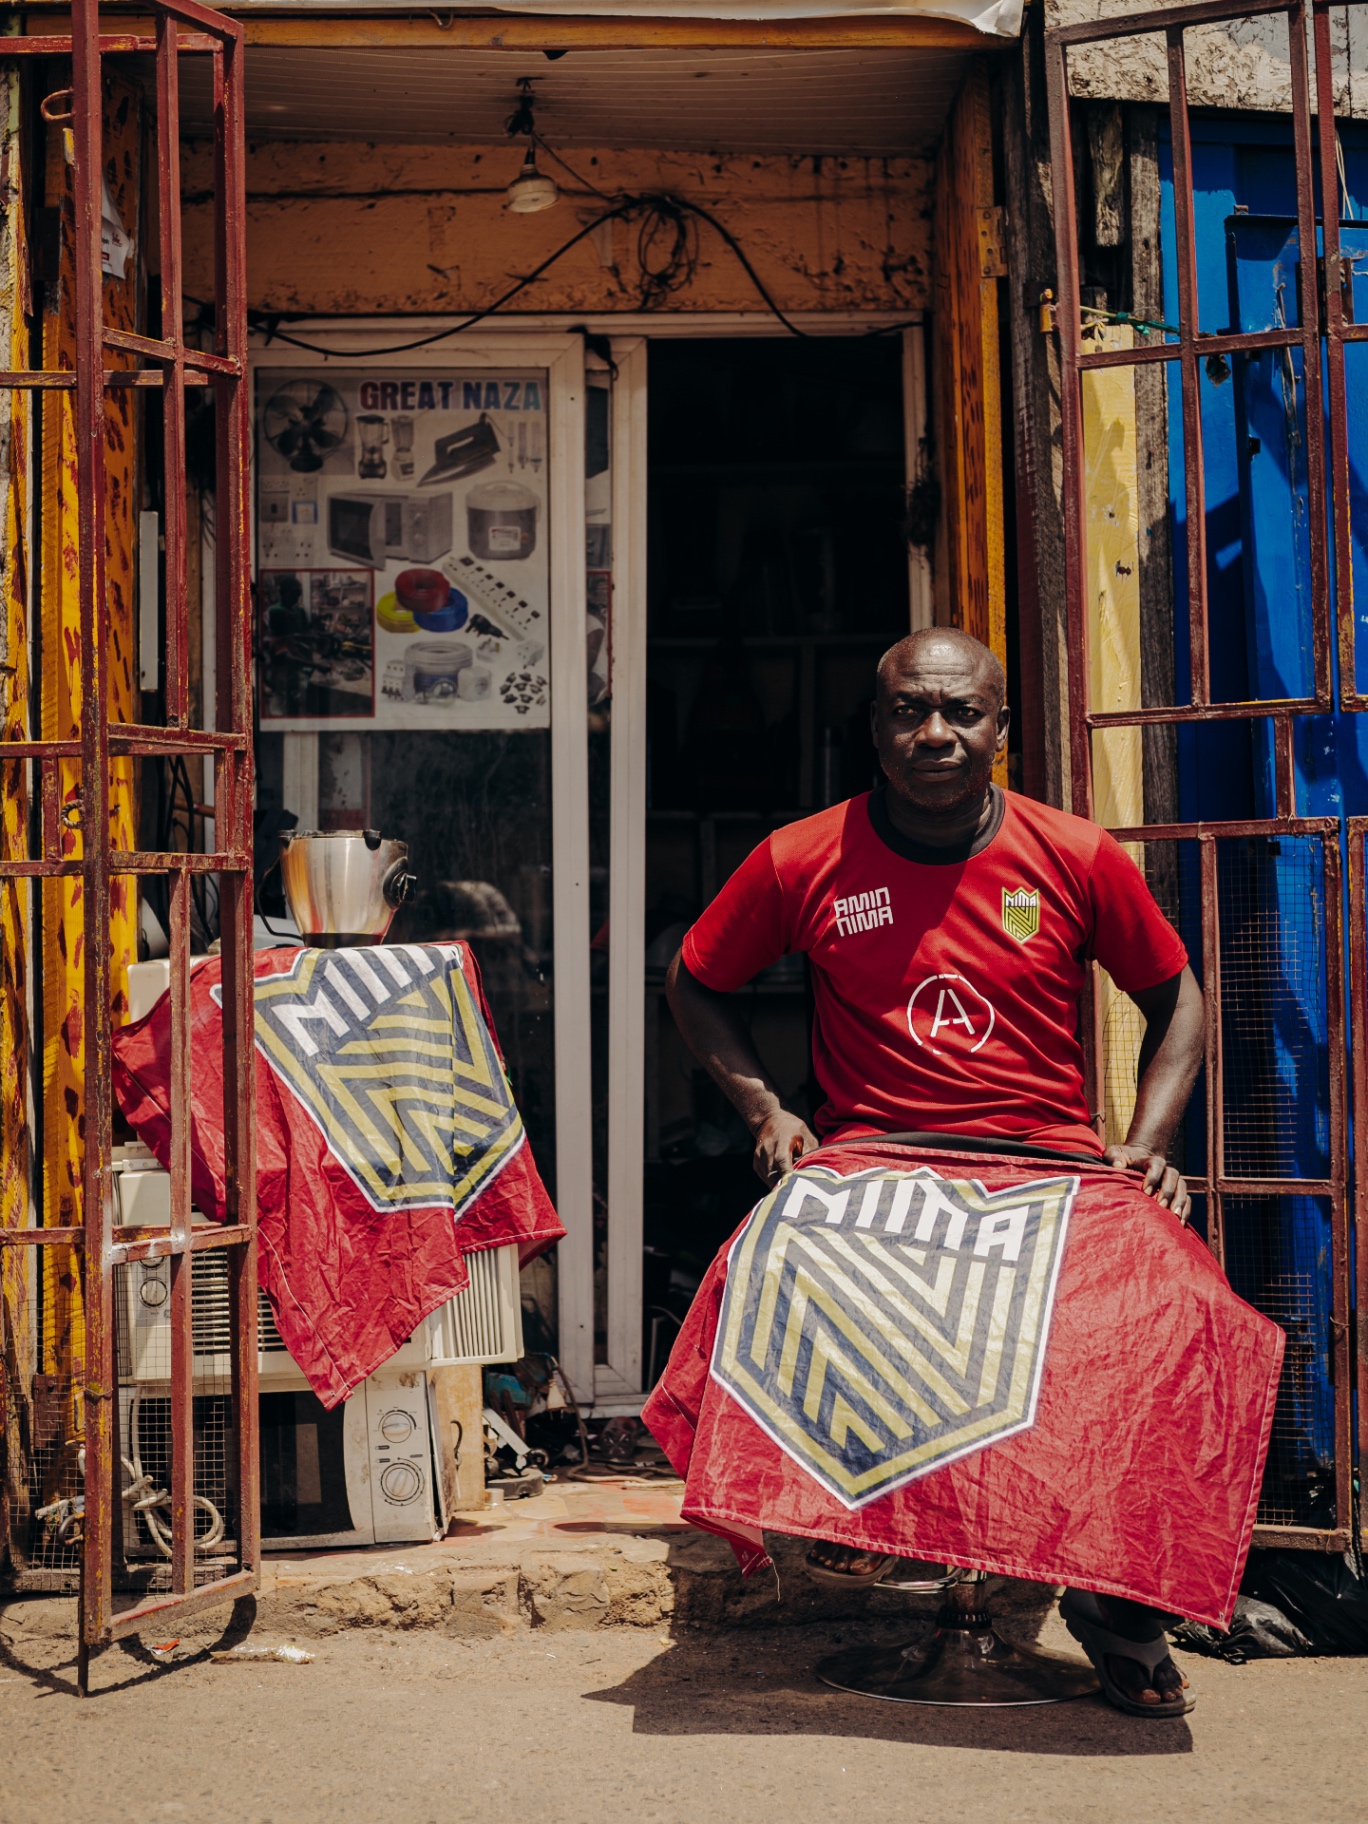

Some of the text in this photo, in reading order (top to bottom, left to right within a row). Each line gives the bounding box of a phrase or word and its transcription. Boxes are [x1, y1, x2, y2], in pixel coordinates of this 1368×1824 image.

[359, 380, 542, 411] GREAT NAZA
[833, 886, 891, 919] AMIN
[930, 988, 976, 1038] A
